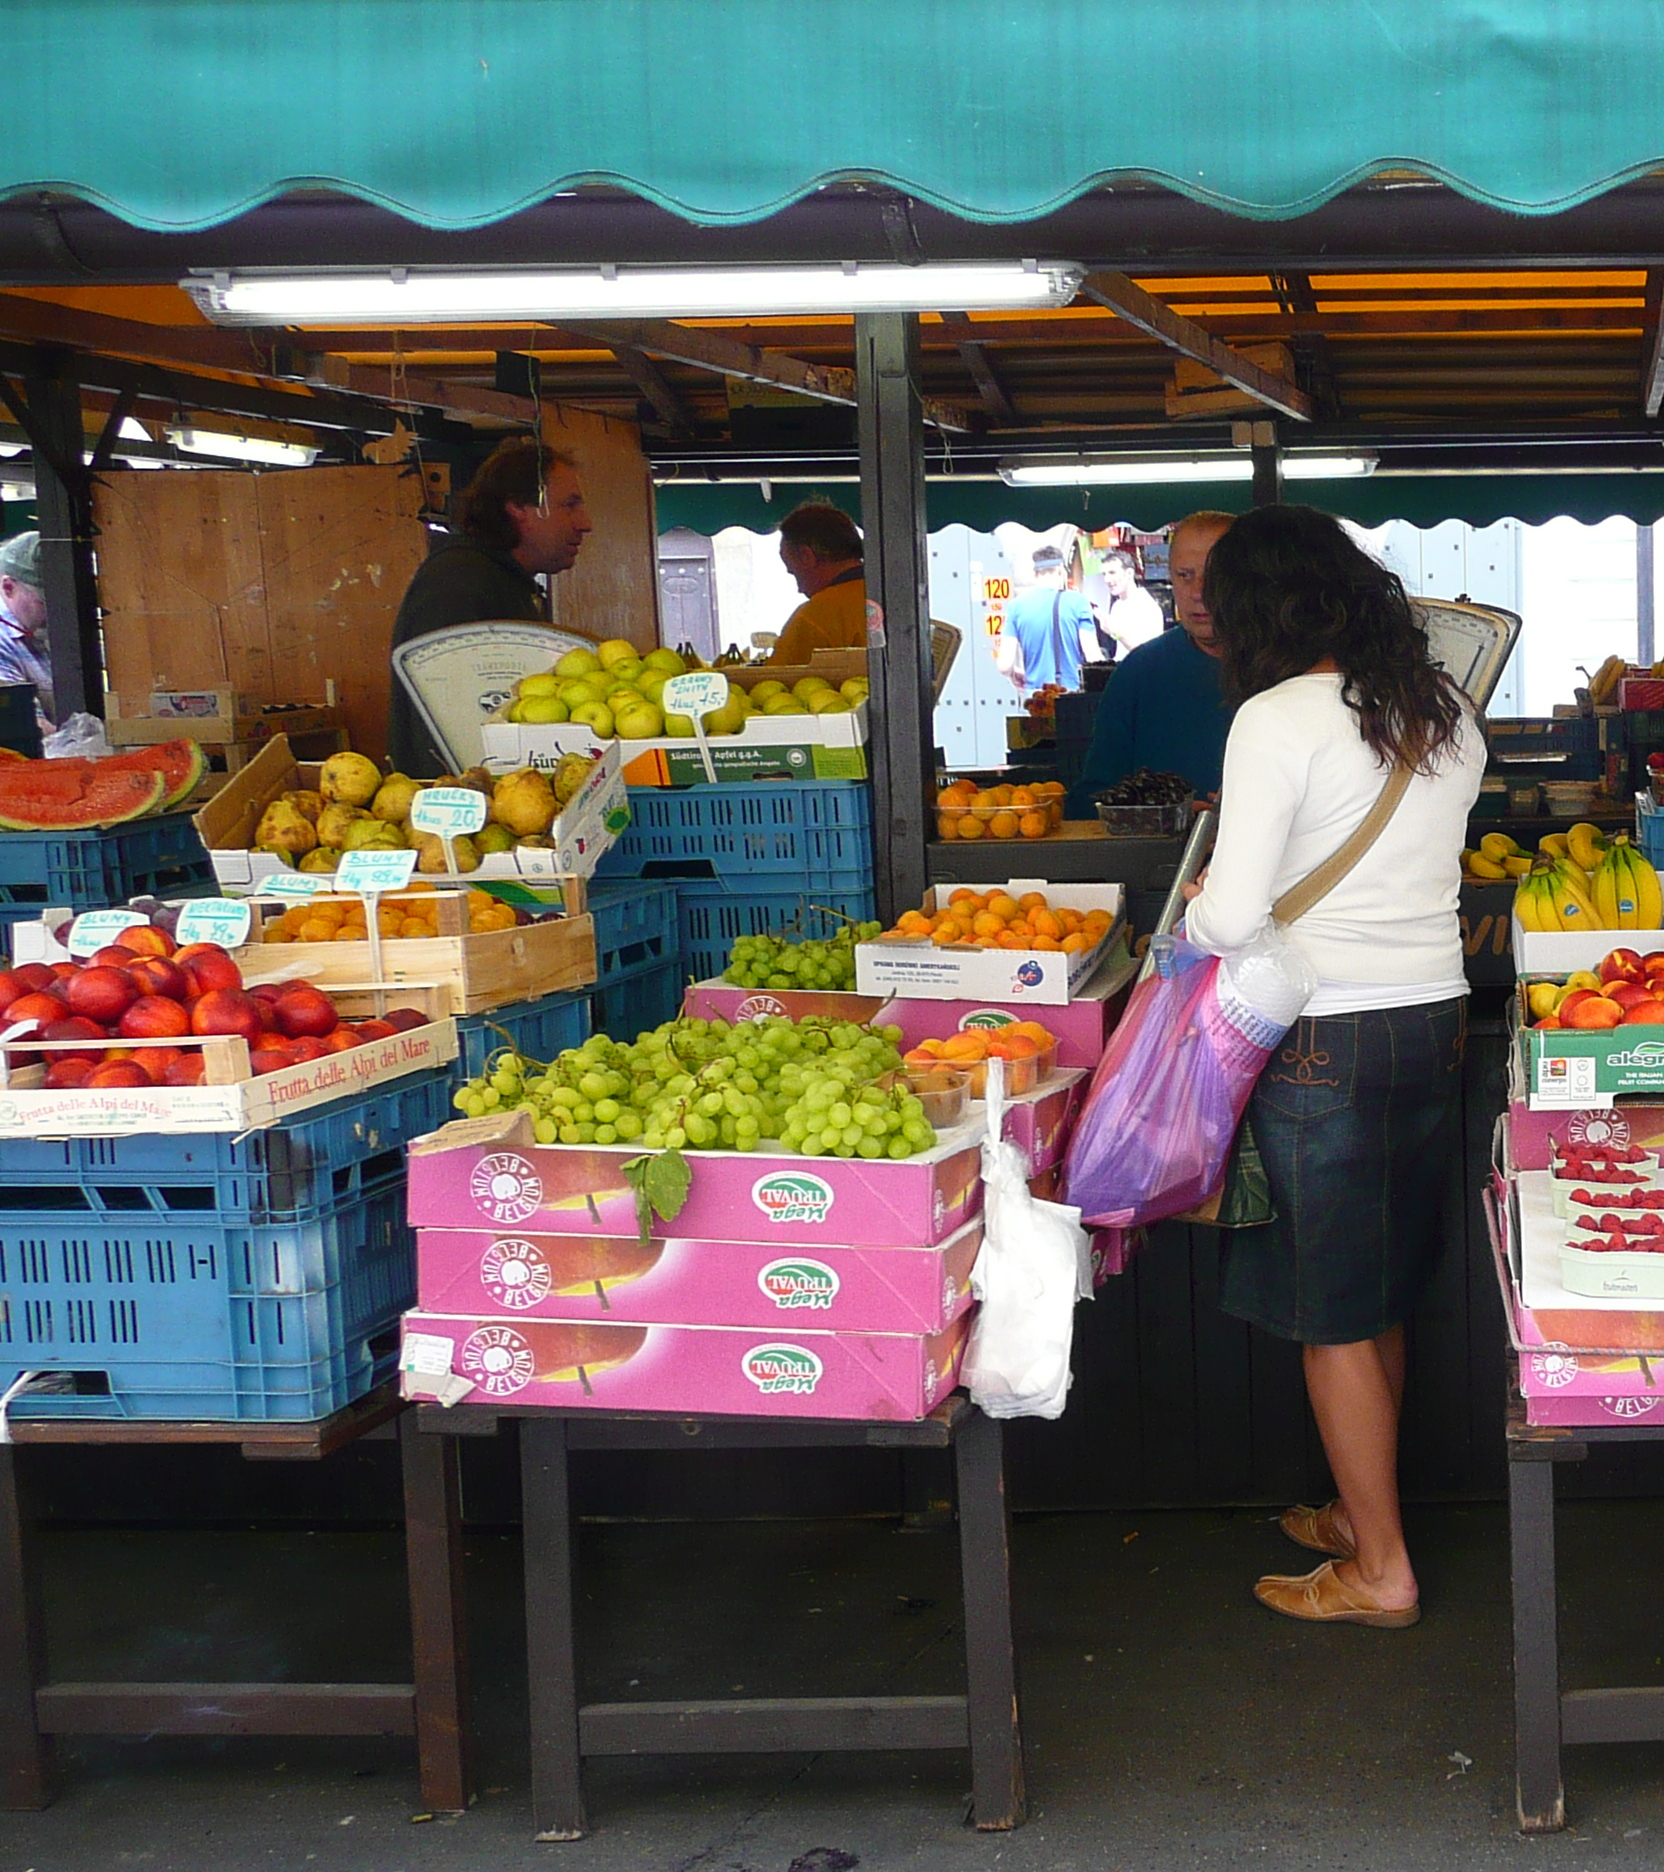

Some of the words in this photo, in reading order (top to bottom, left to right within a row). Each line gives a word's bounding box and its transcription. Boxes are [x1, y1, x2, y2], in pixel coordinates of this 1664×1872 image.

[984, 578, 1010, 599] 120
[986, 615, 1005, 635] 12
[267, 1078, 311, 1105] Frutta
[314, 1061, 346, 1090] delle
[350, 1049, 377, 1079] Alpi
[380, 1043, 397, 1069] del
[401, 1037, 430, 1061] Mare
[472, 1156, 521, 1198] BELGIUM
[493, 1176, 540, 1221] BELGIUM
[762, 1188, 821, 1204] TRUVAL
[772, 1203, 829, 1220] Mega
[483, 1242, 529, 1283] BELGIUM
[503, 1263, 549, 1307] BELGIUM
[768, 1275, 827, 1291] TRUVAL
[778, 1289, 834, 1307] Mega
[465, 1329, 511, 1371] BELGIUM
[486, 1349, 532, 1393] BELGIUM
[752, 1360, 811, 1375] TRUVAL
[761, 1374, 818, 1391] Mega
